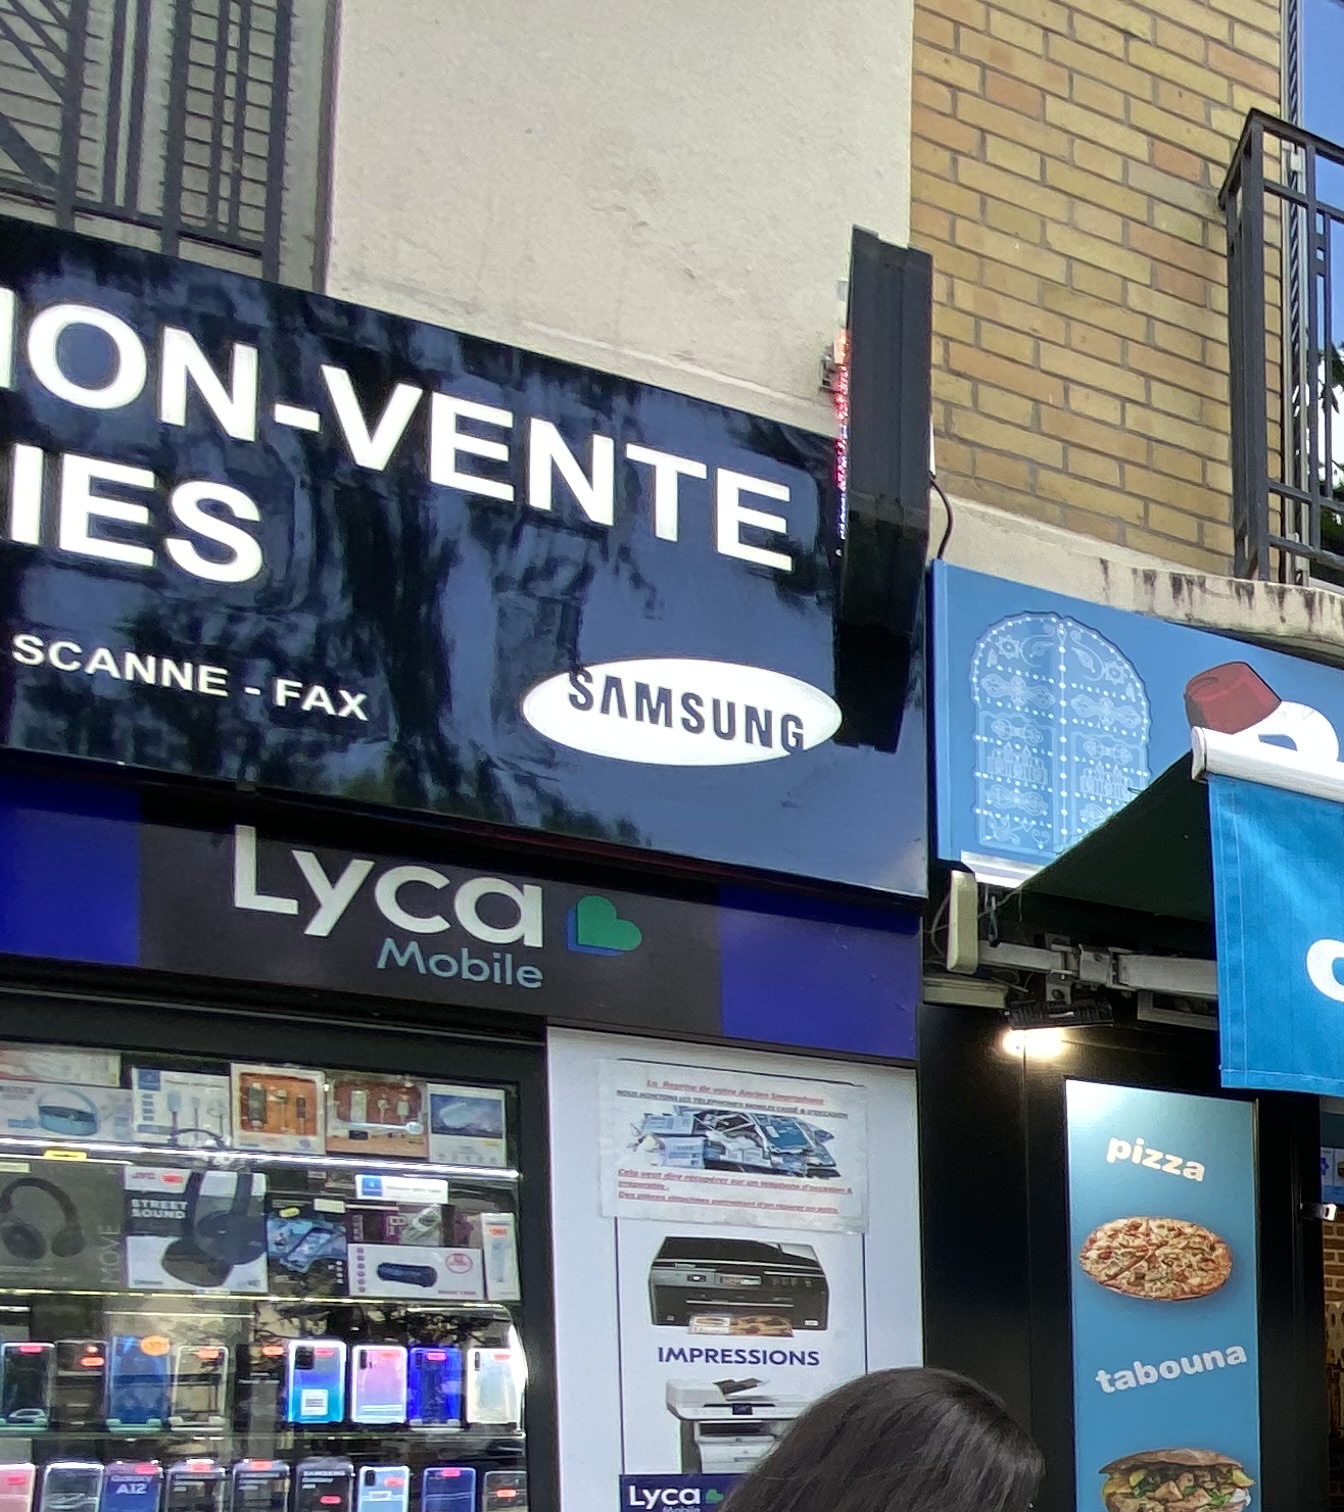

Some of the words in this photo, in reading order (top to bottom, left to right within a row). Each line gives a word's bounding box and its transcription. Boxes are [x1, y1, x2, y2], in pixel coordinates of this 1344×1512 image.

[9, 445, 264, 584] IES
[12, 635, 229, 699] SCANNE
[275, 680, 369, 722] FAX
[568, 670, 805, 756] SAMSUNG
[234, 826, 546, 948] Lyca
[377, 937, 545, 990] Mobile
[1106, 1136, 1206, 1182] pizza
[131, 1199, 188, 1211] STREET
[131, 1208, 186, 1219] SOUND
[657, 1346, 821, 1367] IMPRESSIONS
[1095, 1343, 1248, 1395] tabouna
[116, 1482, 148, 1495] A12
[629, 1485, 701, 1509] Lyca
